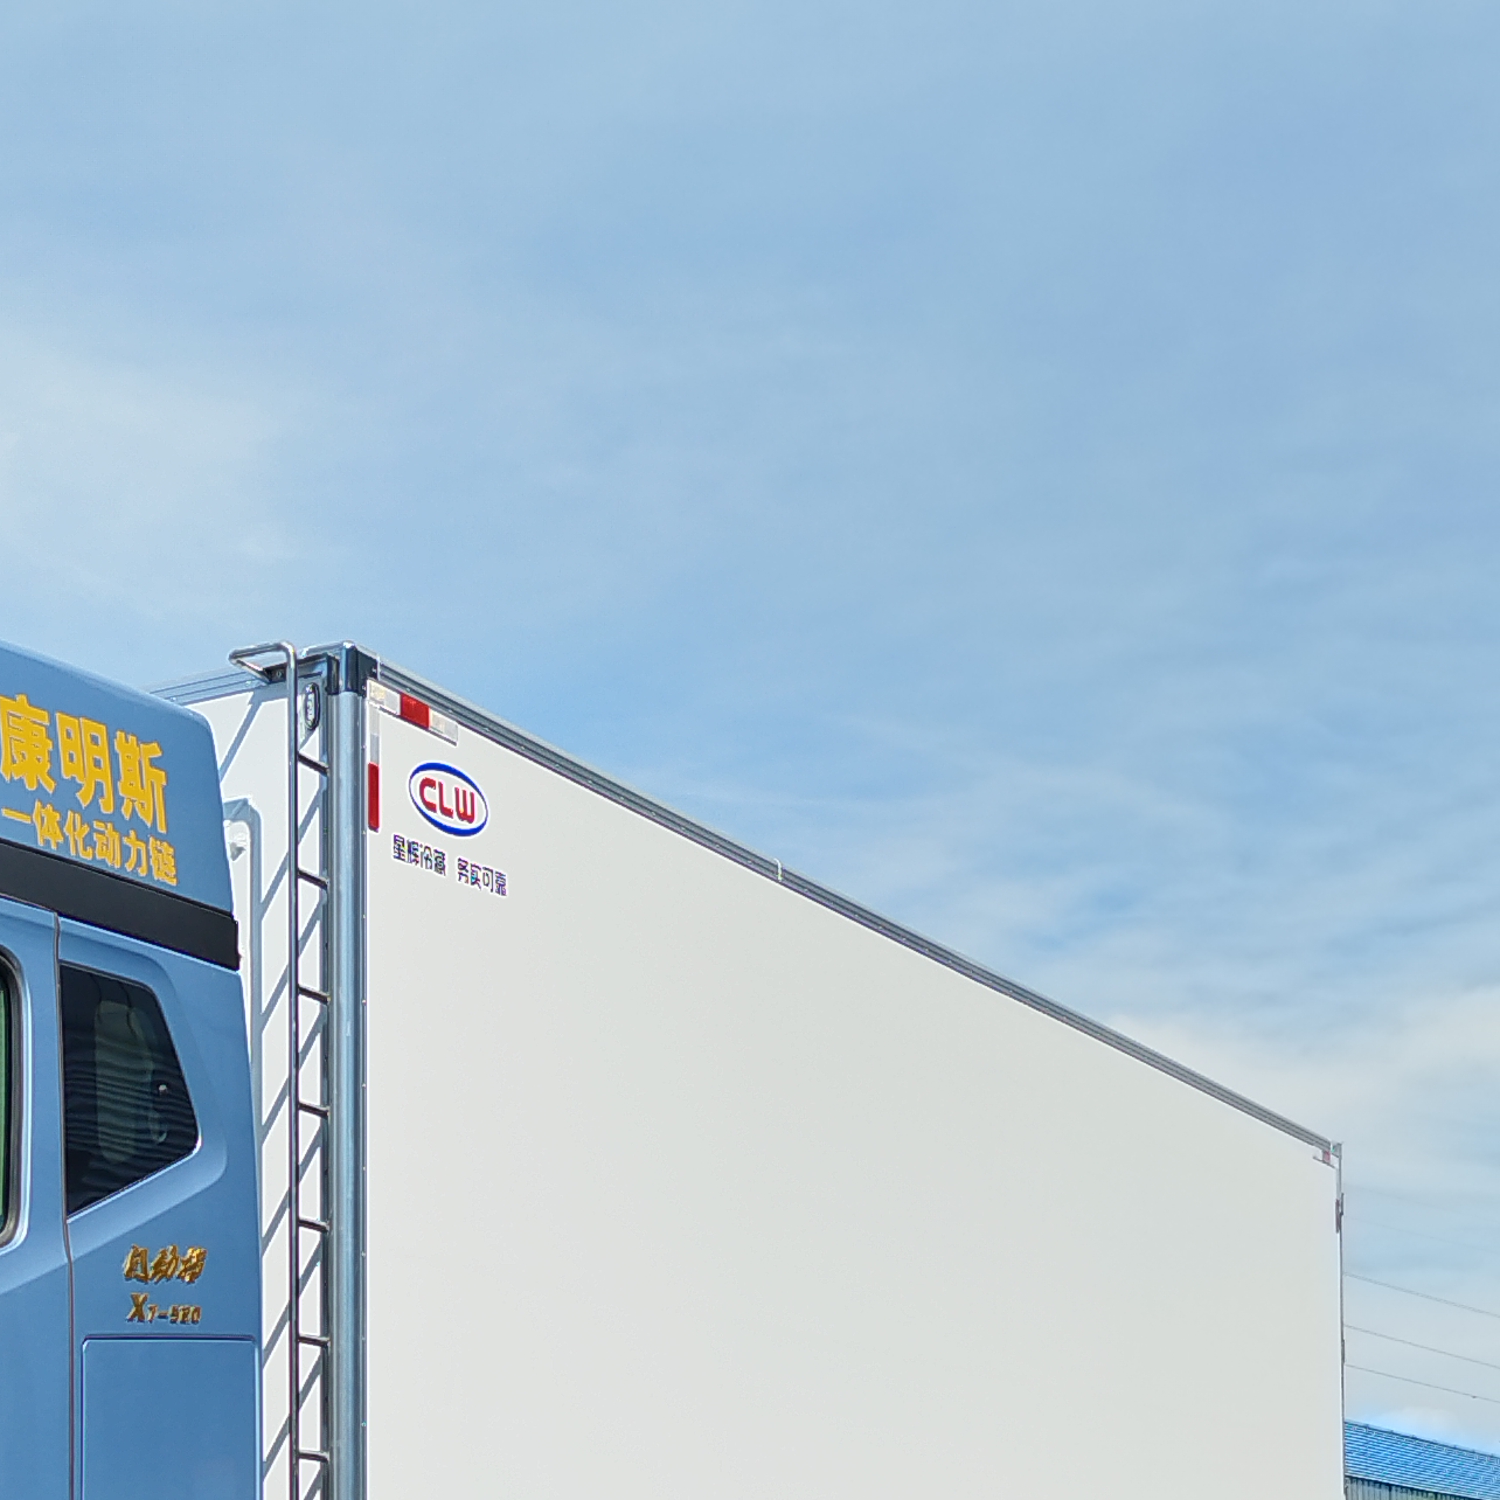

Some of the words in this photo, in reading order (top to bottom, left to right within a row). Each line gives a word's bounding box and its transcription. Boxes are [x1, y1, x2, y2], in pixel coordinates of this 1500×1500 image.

[418, 776, 475, 824] CLW
[1, 799, 178, 886] 一体化动力链
